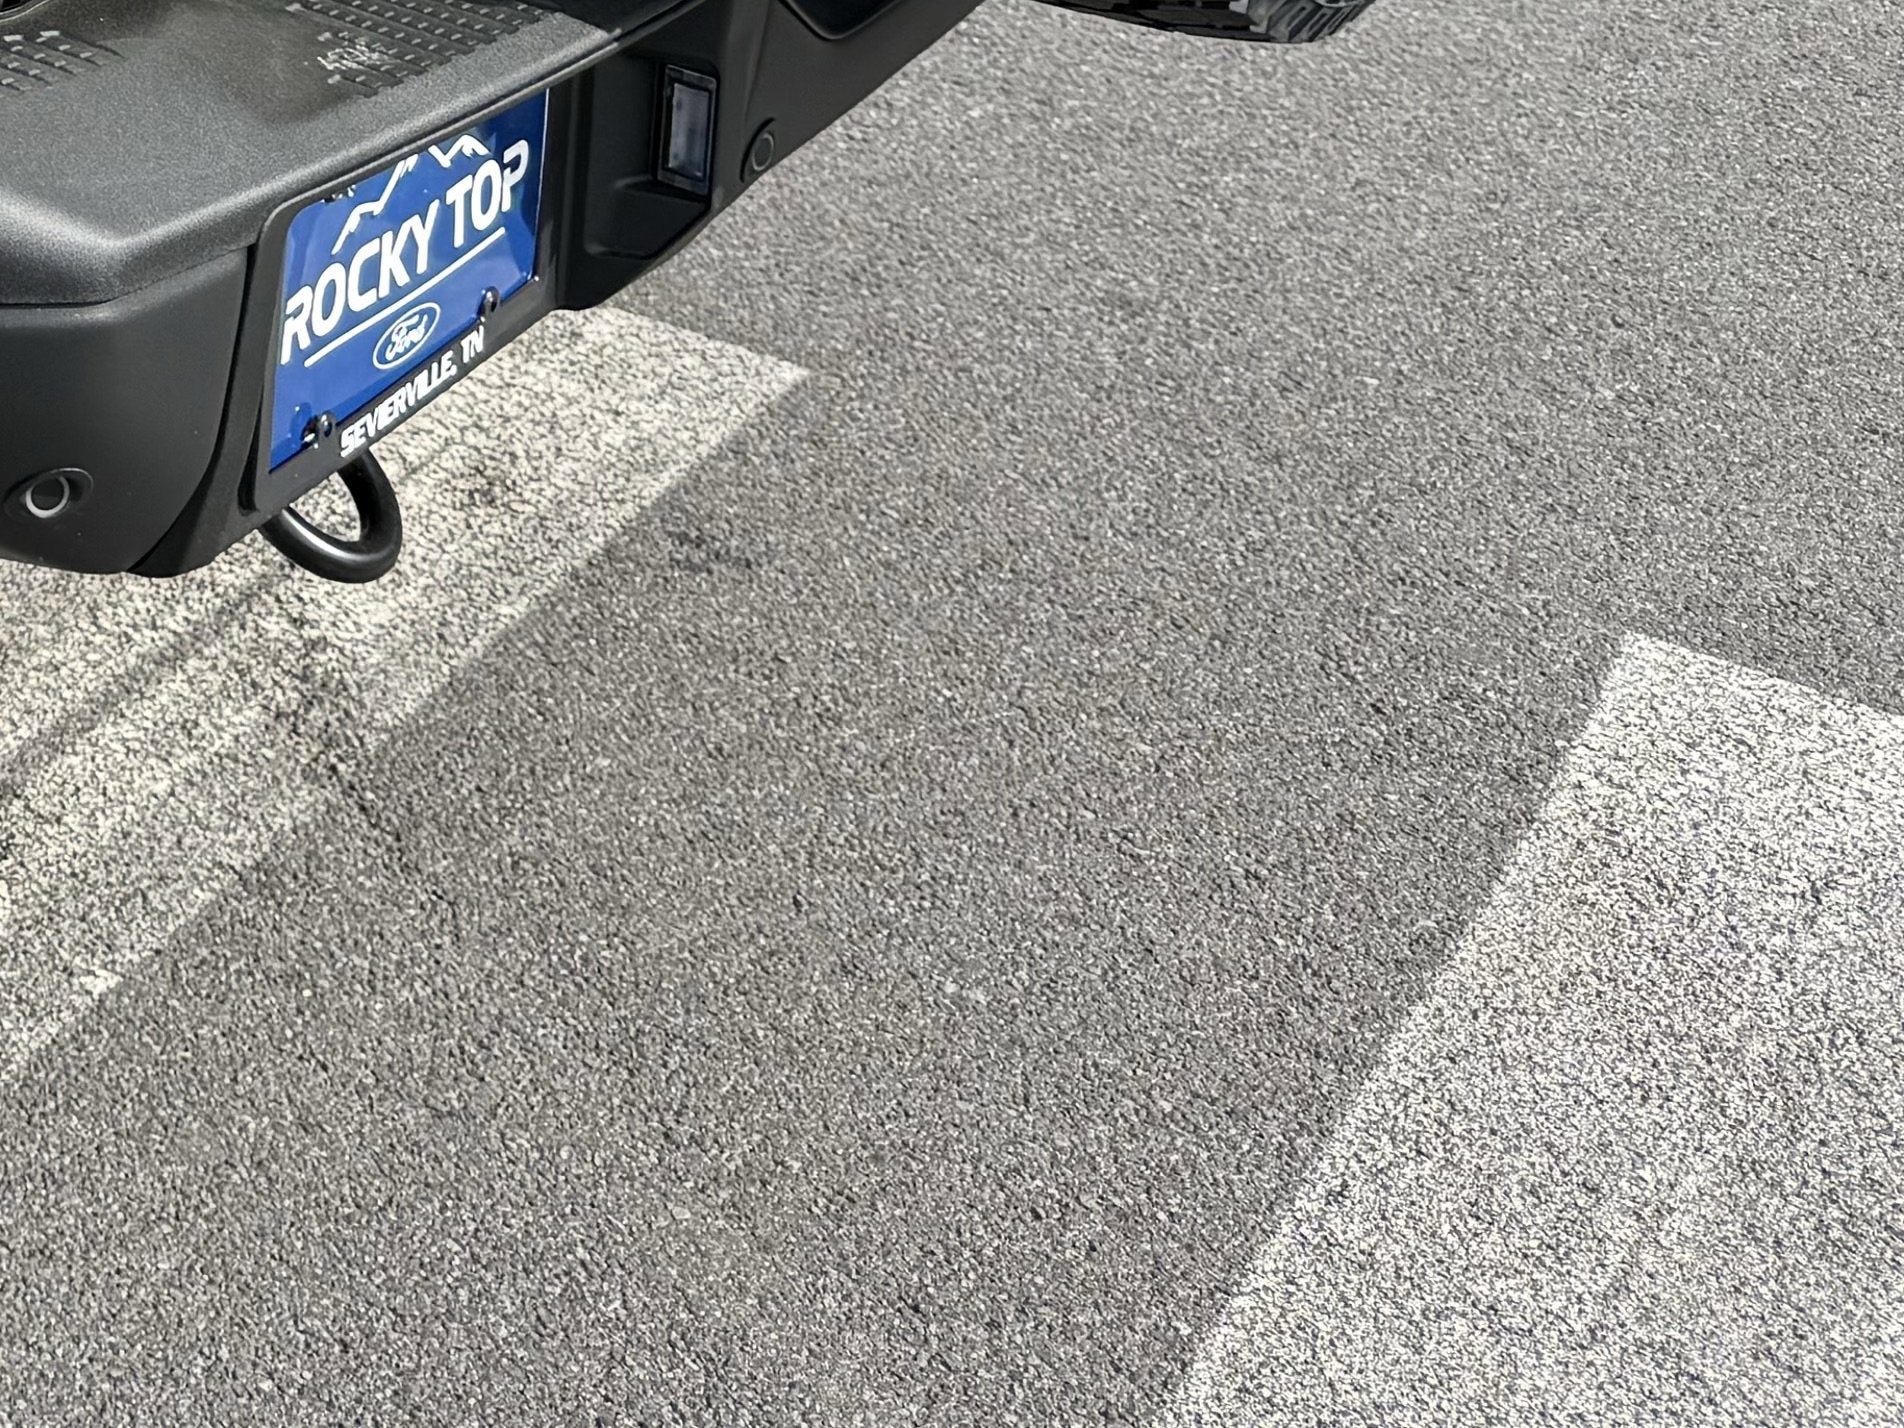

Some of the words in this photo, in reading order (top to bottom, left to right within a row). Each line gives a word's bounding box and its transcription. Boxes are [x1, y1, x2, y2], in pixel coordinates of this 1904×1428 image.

[279, 198, 440, 366] ROCKY
[445, 138, 530, 249] TOP
[339, 349, 458, 458] SEVIERVILLE,
[460, 324, 486, 364] TN
[384, 312, 429, 361] Ford
